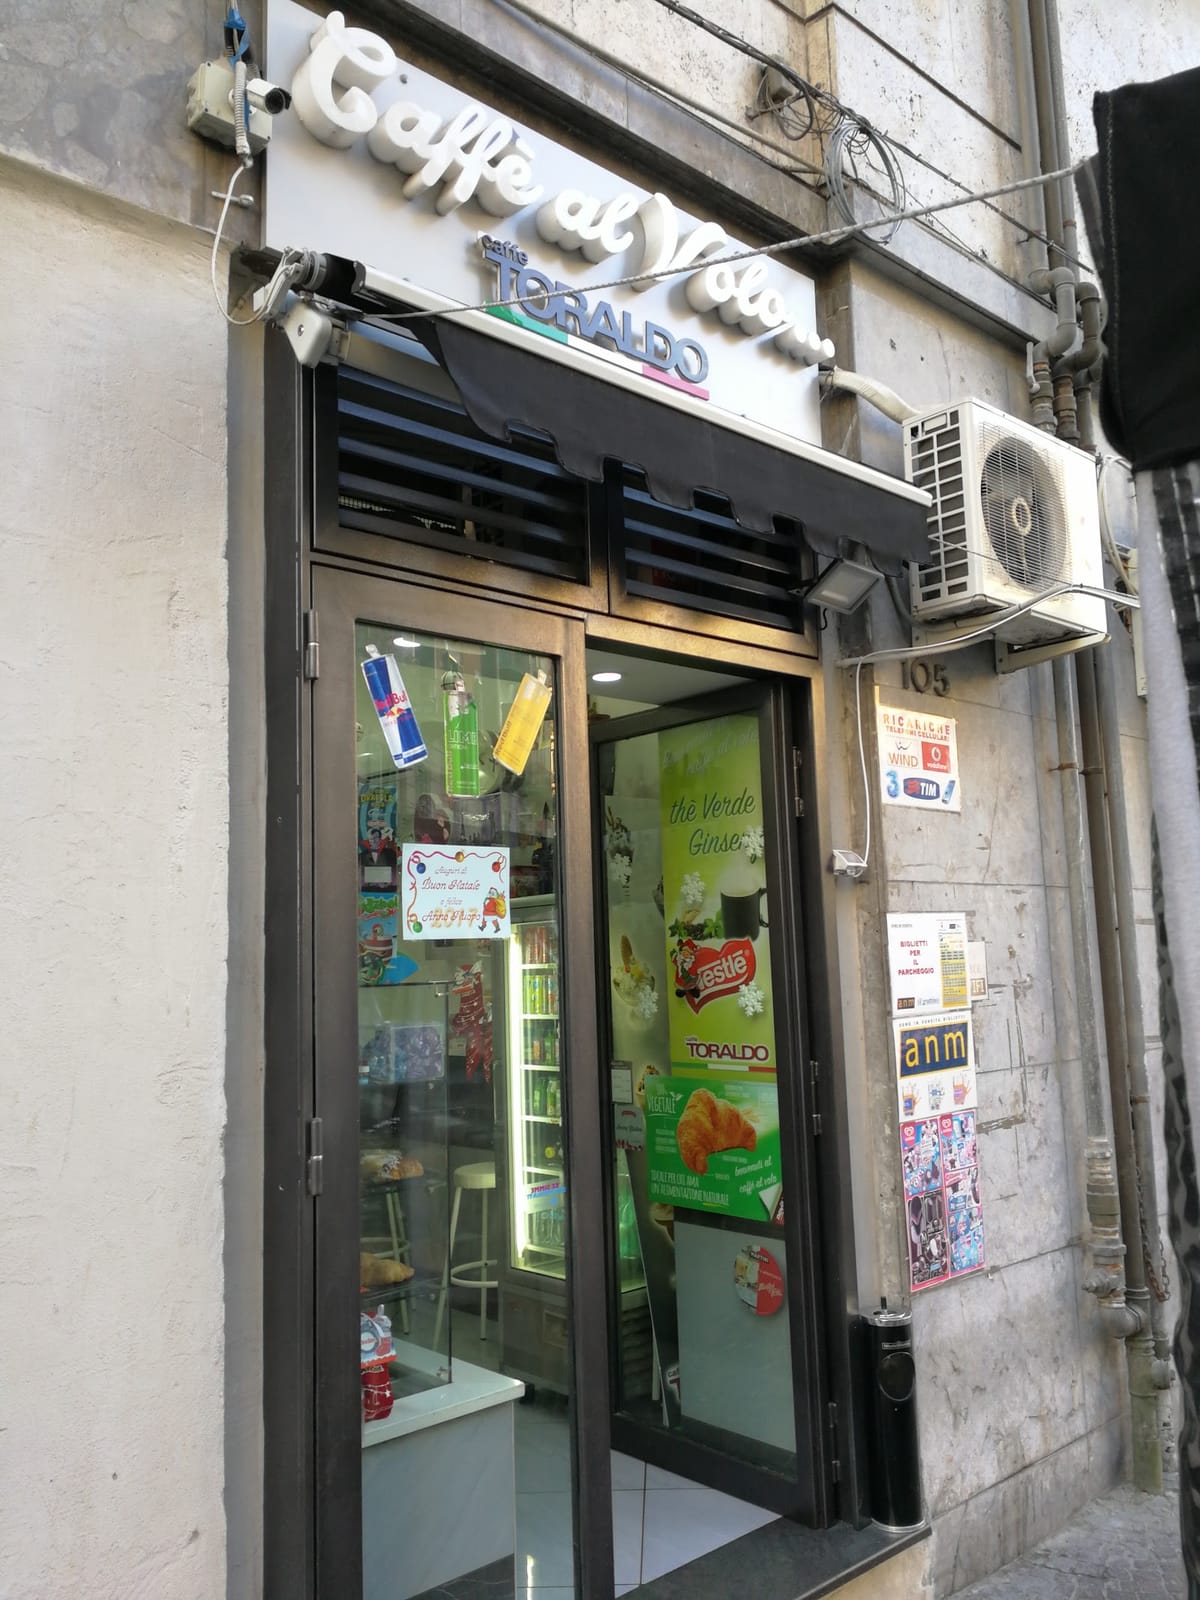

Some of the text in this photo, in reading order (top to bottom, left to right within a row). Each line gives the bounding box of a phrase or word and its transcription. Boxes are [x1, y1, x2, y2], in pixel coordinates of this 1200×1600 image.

[293, 11, 544, 216] Caffè
[537, 188, 638, 264] al
[485, 250, 709, 384] TORALDO
[901, 657, 950, 697] 105
[883, 713, 951, 735] RICARICHE
[889, 753, 918, 768] WIND
[920, 782, 937, 797] TIM
[670, 787, 756, 825] thè Verde
[421, 877, 480, 890] Buon Natale
[900, 940, 929, 948] BIGLIETTI
[909, 949, 921, 957] PER
[898, 967, 935, 976] PARCHEGGIO
[686, 1042, 769, 1061] TORALDO
[905, 1030, 966, 1068] anm
